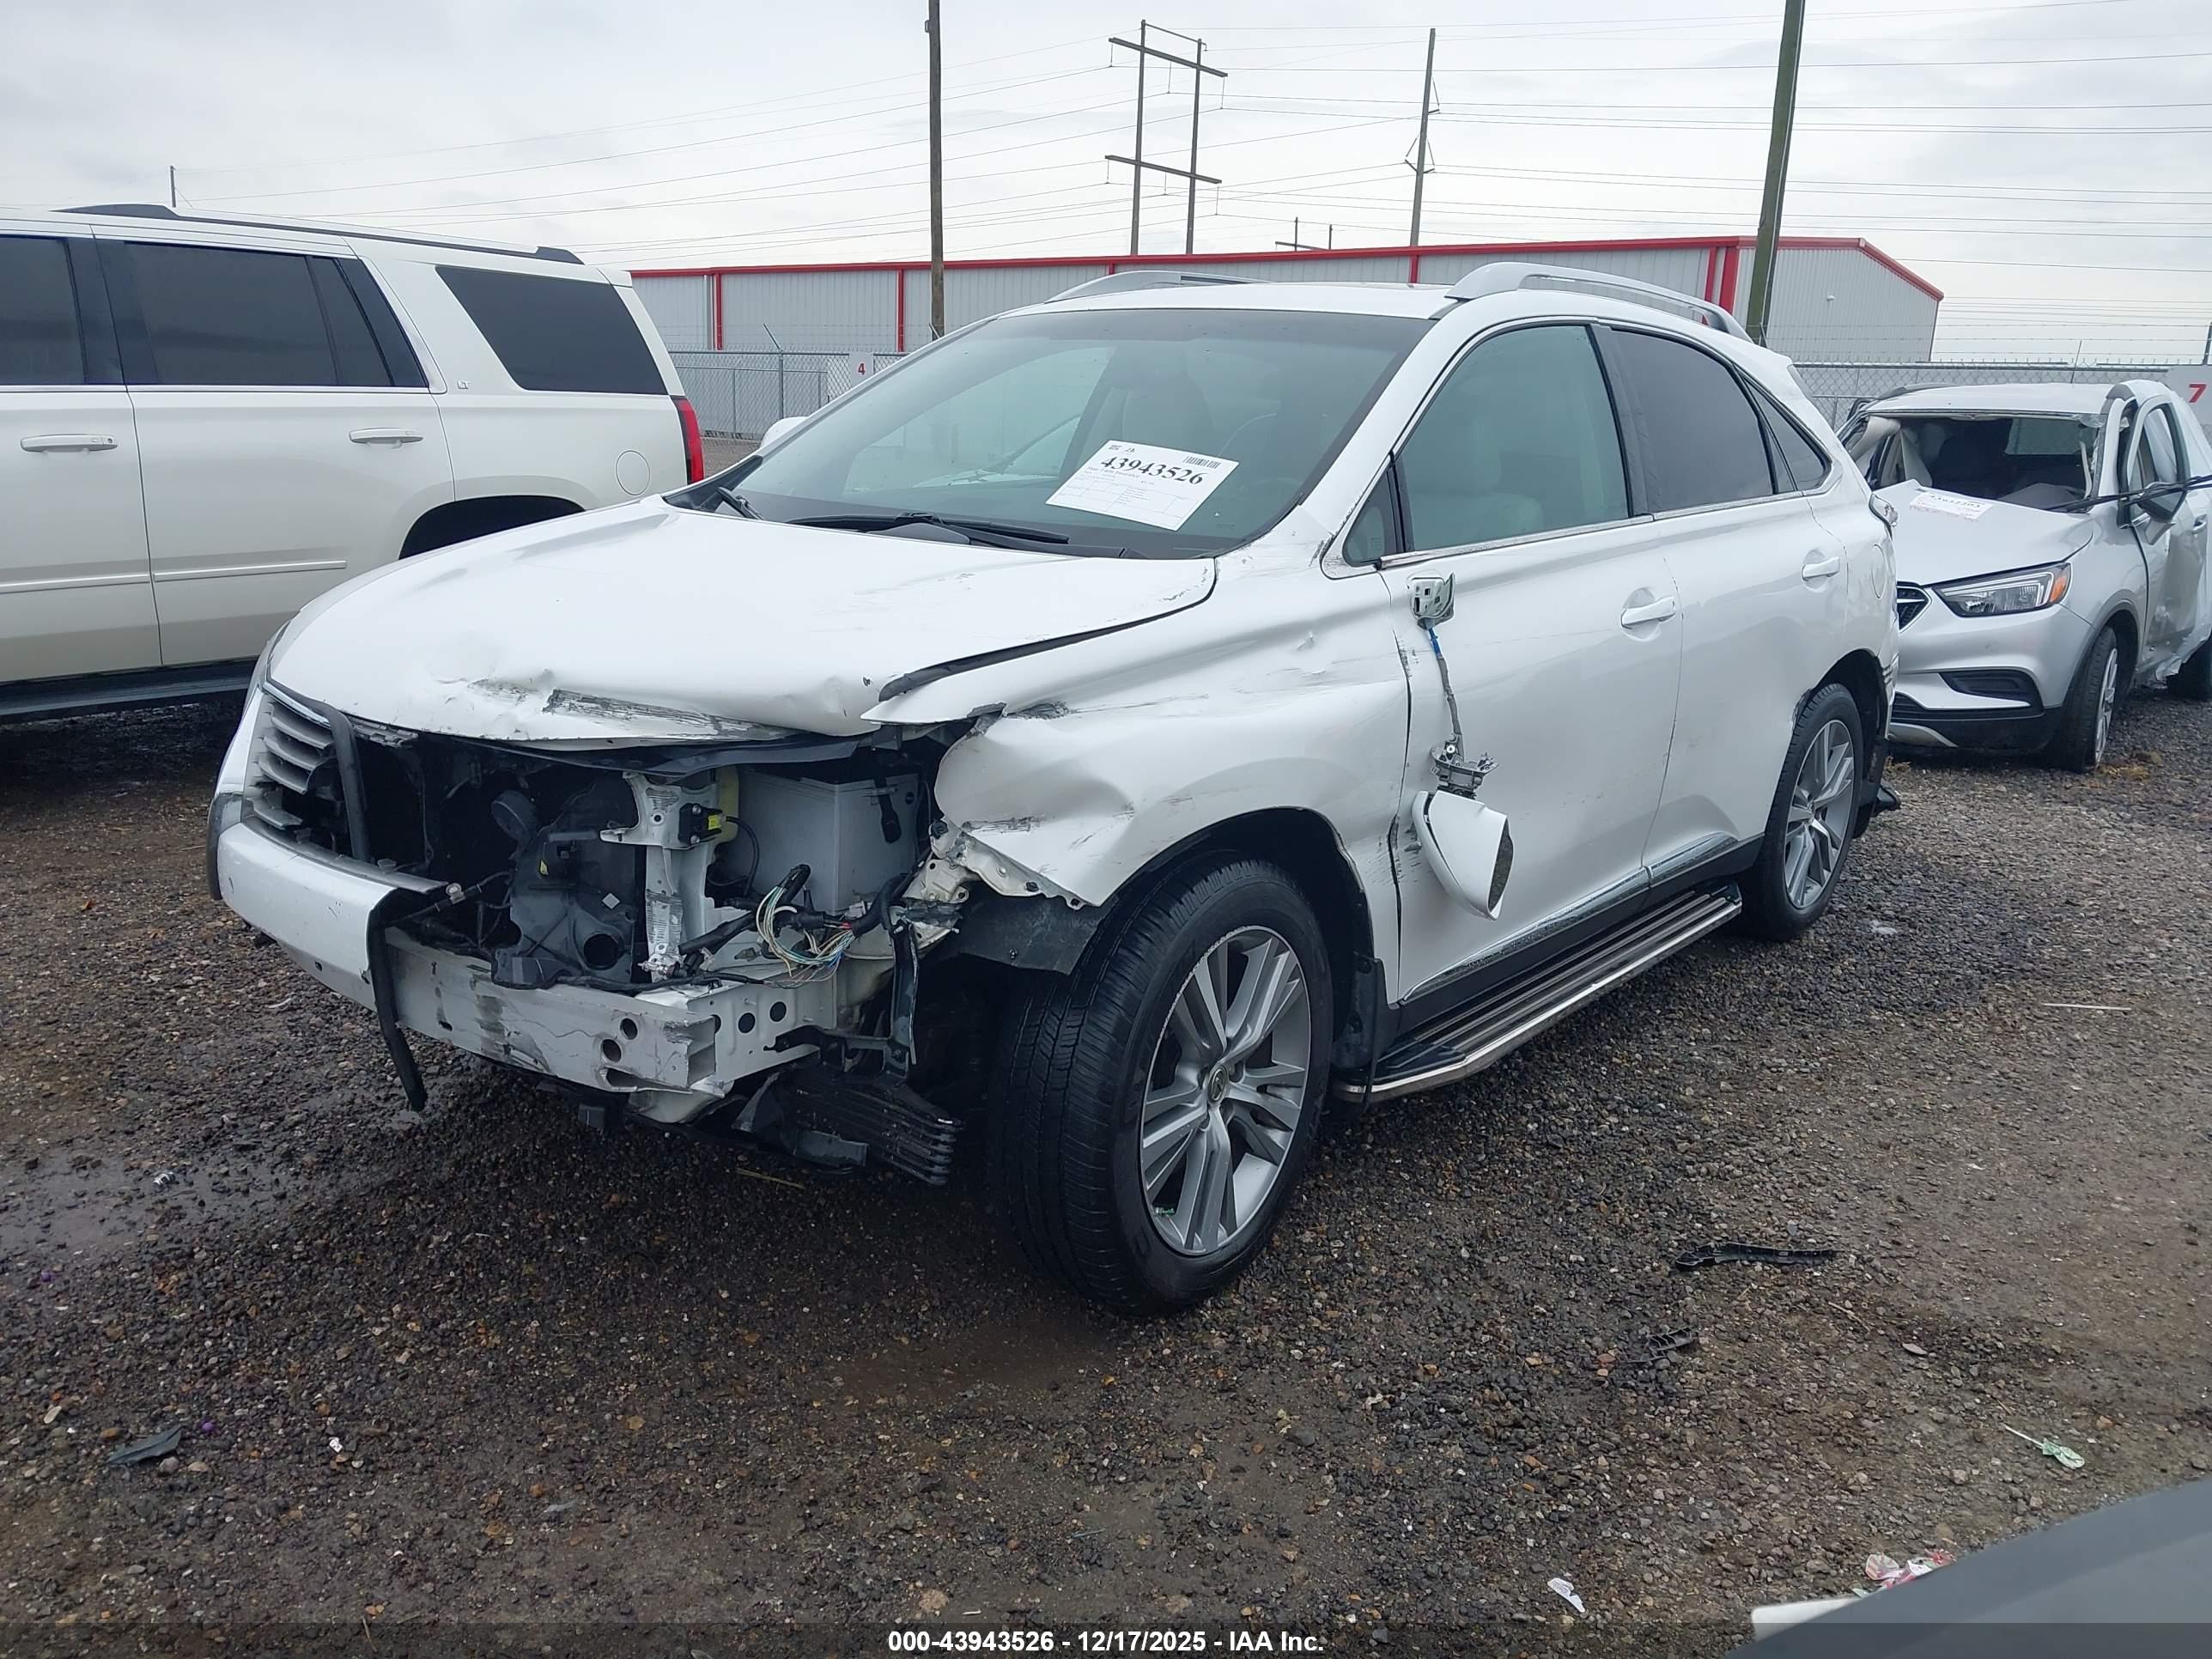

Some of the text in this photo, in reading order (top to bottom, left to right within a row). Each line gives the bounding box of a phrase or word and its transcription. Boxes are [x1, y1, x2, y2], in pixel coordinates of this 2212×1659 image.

[858, 362, 866, 376] 4
[2189, 383, 2207, 404] 7
[1100, 456, 1208, 485] 43943526
